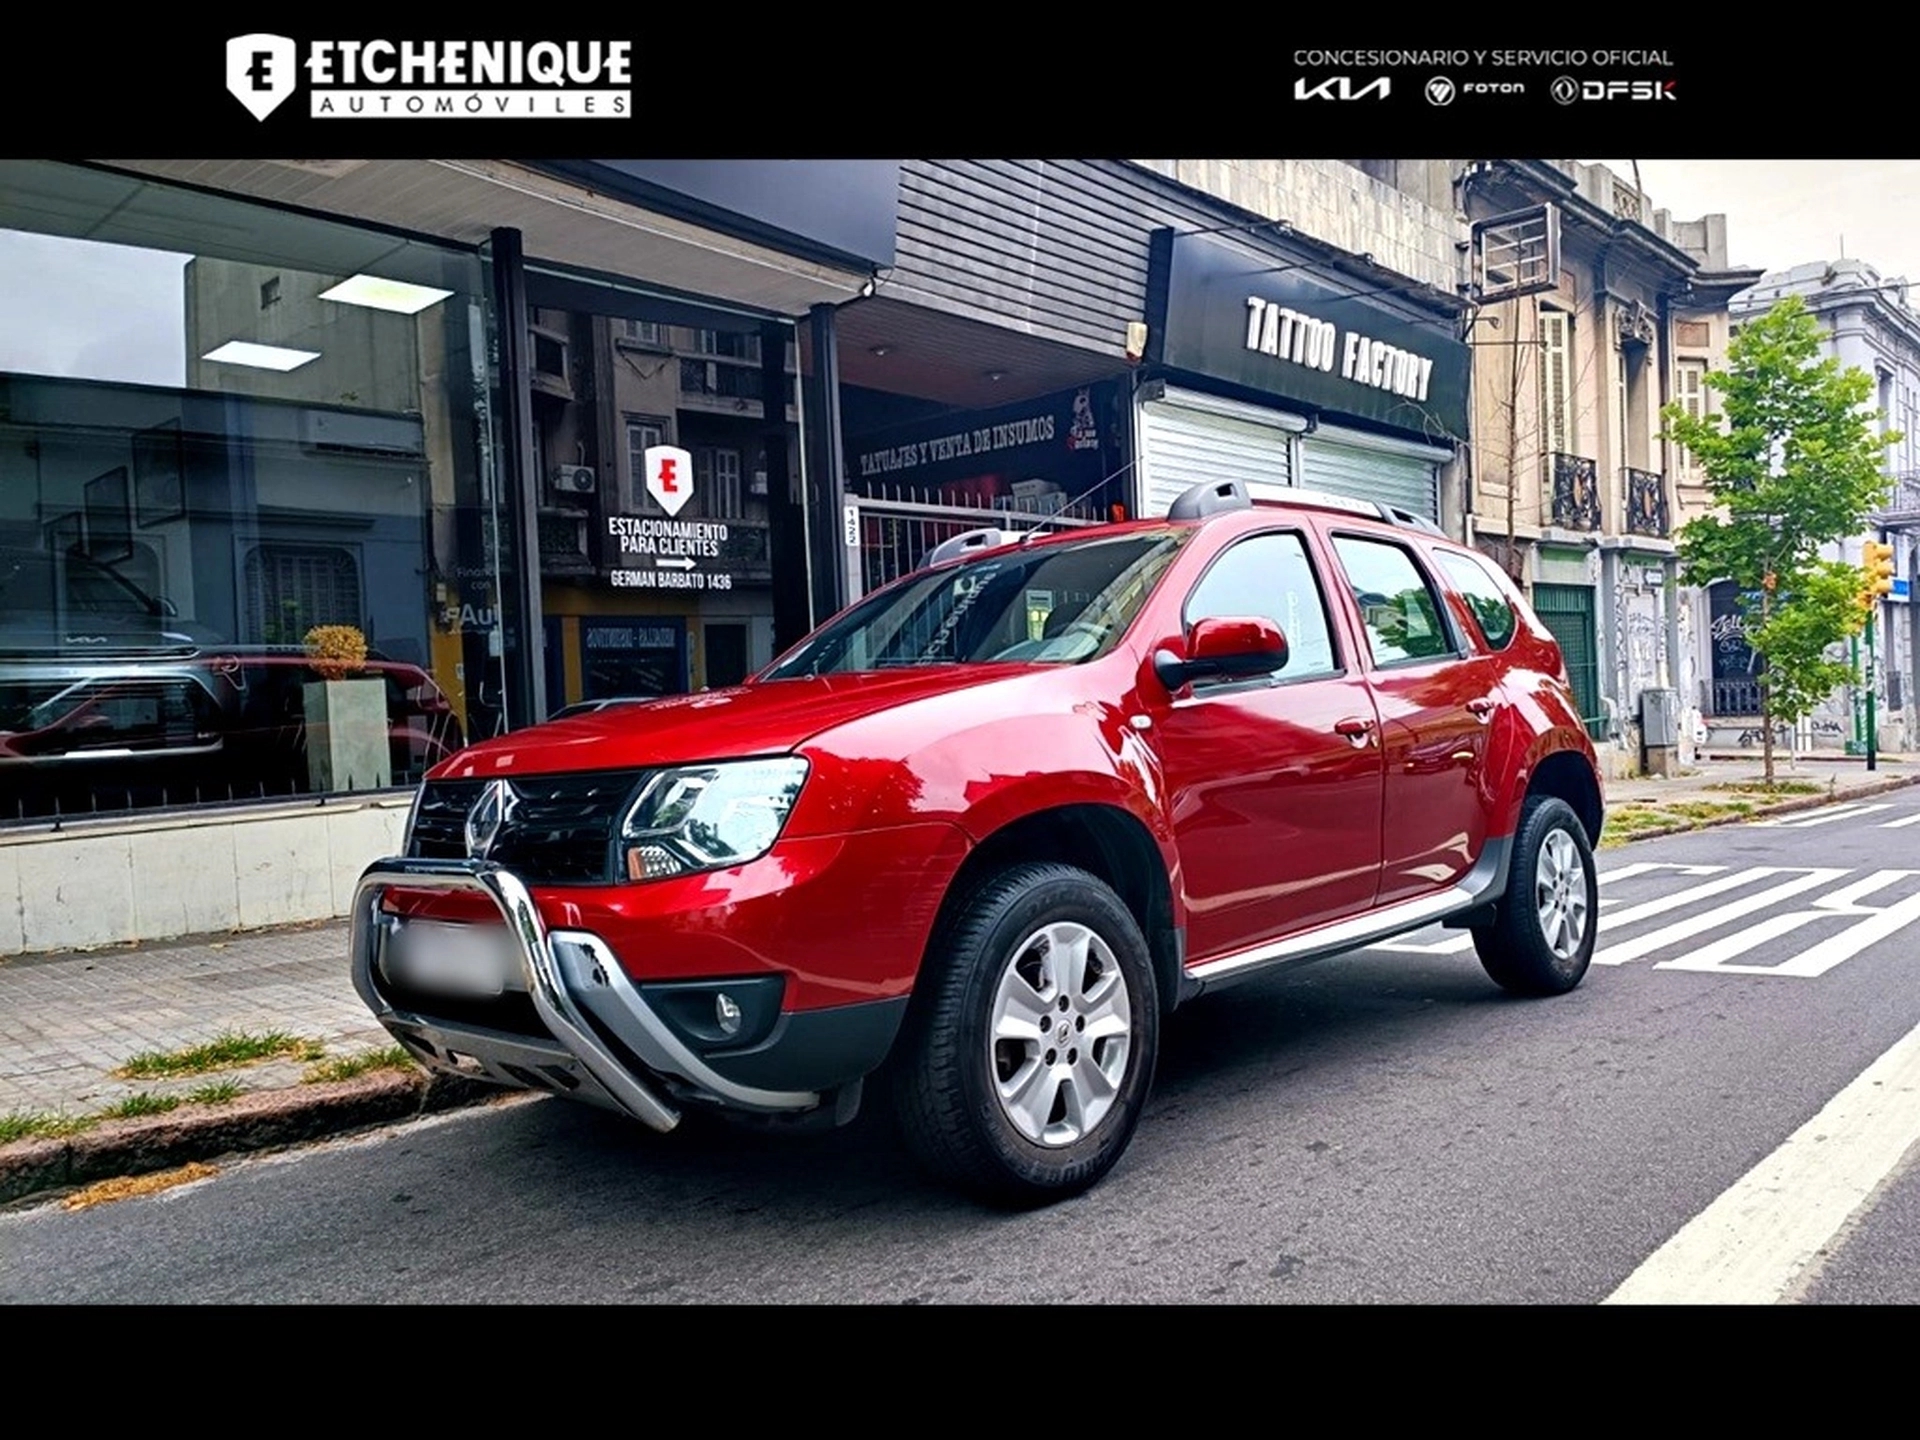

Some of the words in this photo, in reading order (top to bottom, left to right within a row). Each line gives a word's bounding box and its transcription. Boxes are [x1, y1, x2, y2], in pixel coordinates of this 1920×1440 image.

[1246, 296, 1336, 373] TATTOO
[1341, 331, 1434, 402] FACTORY
[859, 441, 919, 475] TATUAJES
[919, 440, 929, 465] Y
[929, 430, 972, 461] VENTA
[973, 426, 992, 453] DE
[992, 414, 1055, 449] INSUMOS
[608, 516, 728, 542] ESTACIONAMIENTO
[620, 535, 656, 555] PARA
[659, 538, 719, 557] CLIENTES
[610, 570, 655, 588] GERMAN
[657, 573, 704, 589] BARBATO
[706, 574, 732, 590] 1436
